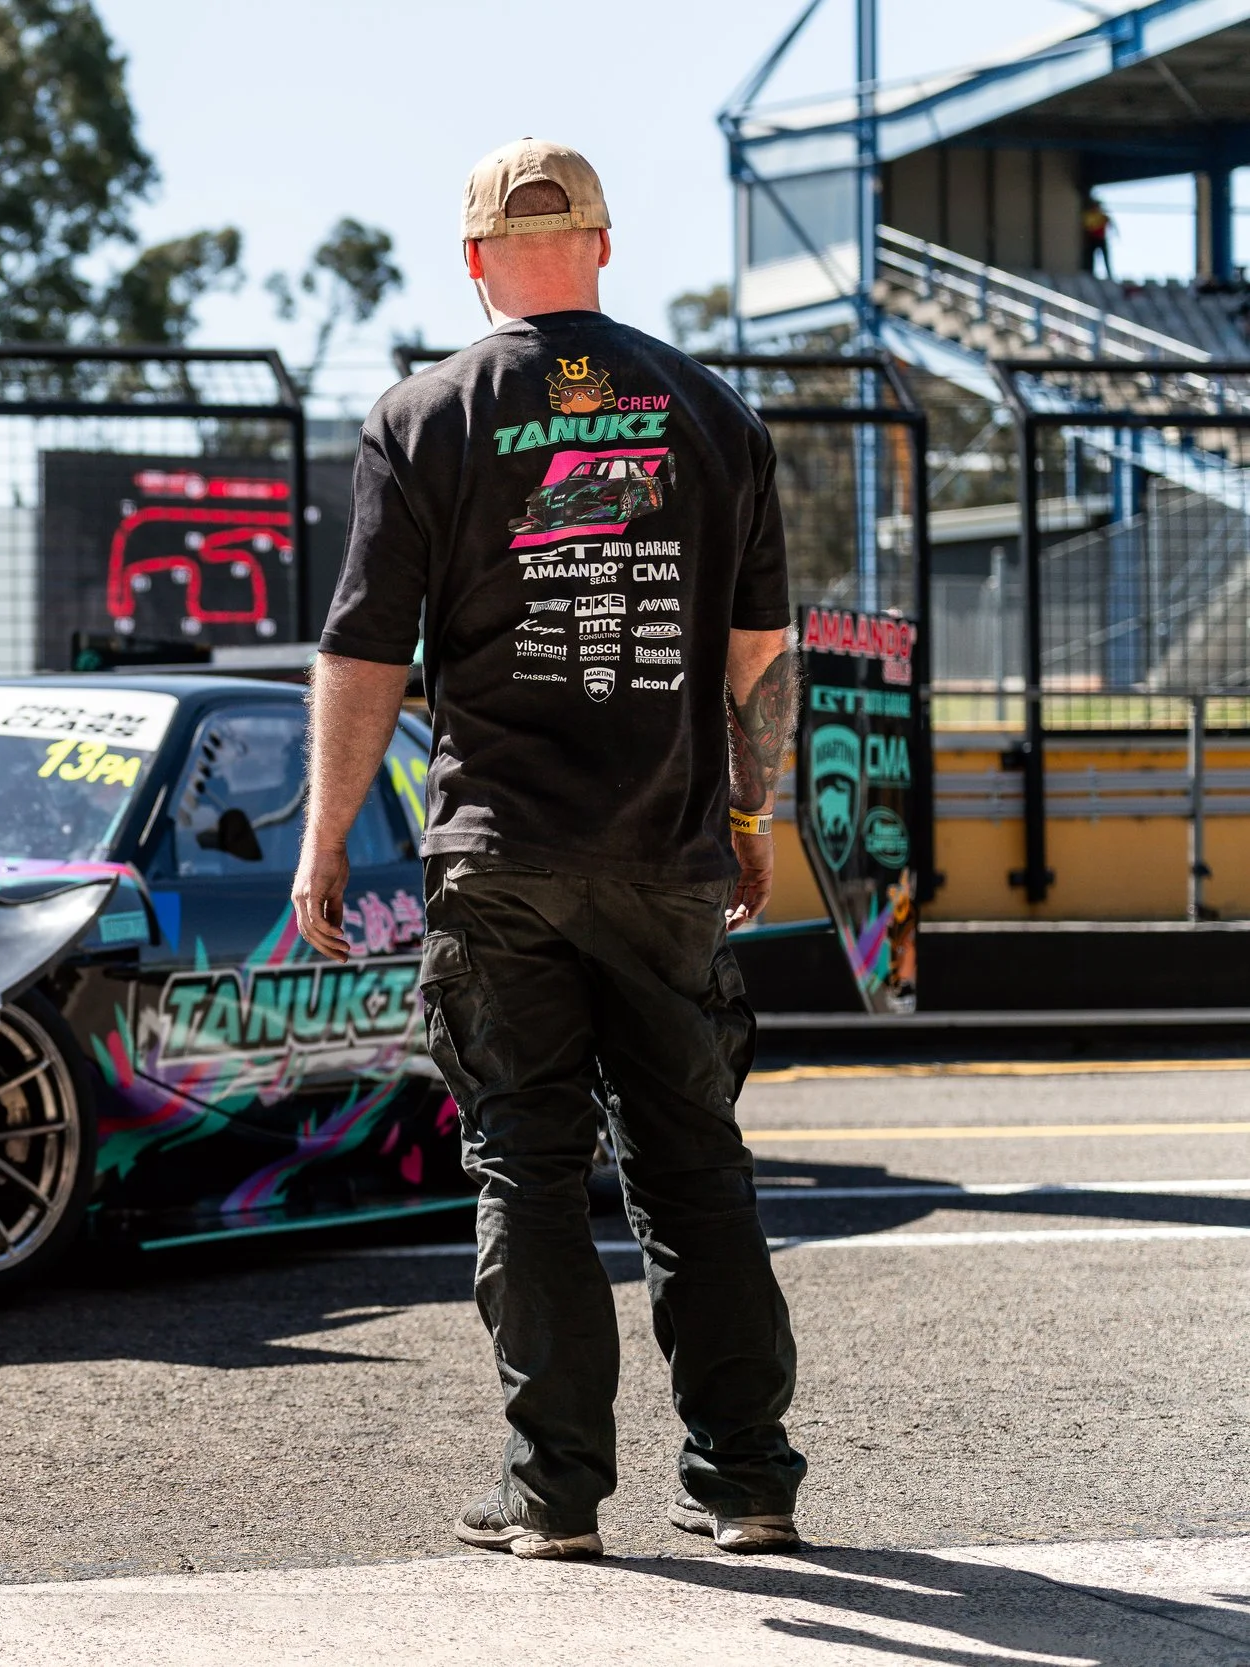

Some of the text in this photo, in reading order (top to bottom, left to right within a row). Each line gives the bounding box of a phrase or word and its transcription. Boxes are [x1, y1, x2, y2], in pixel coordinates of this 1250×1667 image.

[617, 395, 671, 411] CREW
[493, 411, 670, 455] TANUKI
[602, 542, 632, 558] AUTO
[636, 541, 681, 557] GARAGE
[632, 562, 681, 582] CMA
[590, 575, 618, 585] SEALS
[575, 594, 626, 614] HKS
[515, 619, 566, 635] Koya
[579, 618, 622, 634] mmc
[636, 624, 677, 638] PWR
[578, 632, 621, 641] CONSULTING
[515, 640, 568, 656] vibrant
[579, 644, 621, 655] BOSCH
[635, 646, 681, 658] Resolve
[516, 651, 567, 661] performance
[579, 654, 620, 662] Motorsport
[585, 669, 615, 679] MARTINI
[631, 677, 669, 690] alcon
[166, 963, 420, 1052] TANUKI
